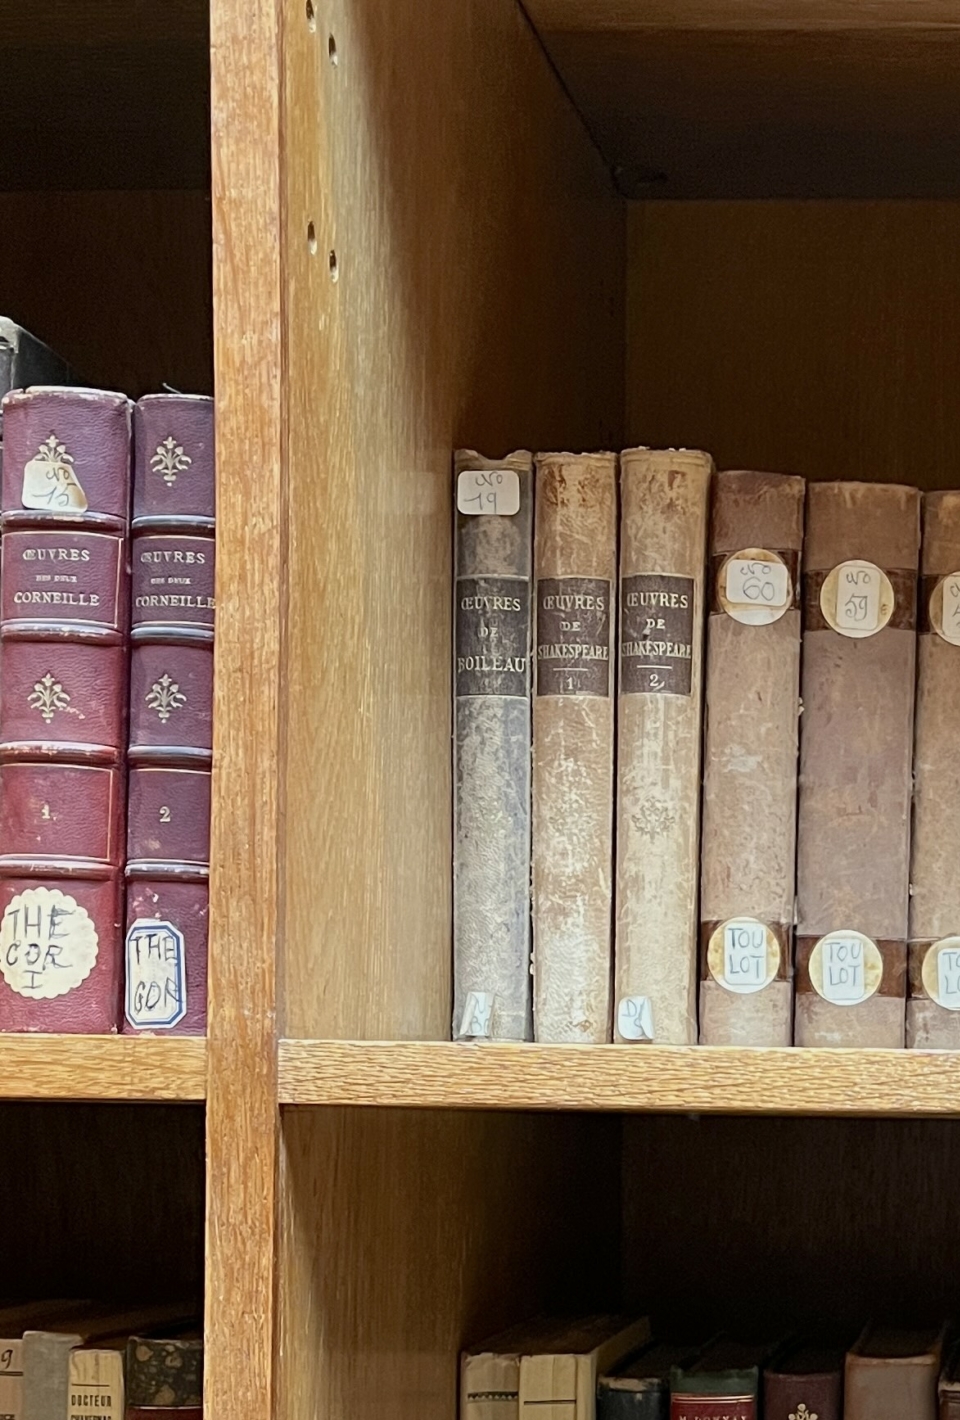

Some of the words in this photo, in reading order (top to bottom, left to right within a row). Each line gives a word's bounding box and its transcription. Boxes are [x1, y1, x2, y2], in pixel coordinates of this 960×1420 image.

[22, 549, 91, 562] ŒUVRES
[742, 576, 776, 601] 60
[14, 591, 100, 607] CORNEILLE
[461, 596, 521, 611] ŒUVRES
[543, 595, 605, 611] ŒUVRES
[627, 592, 689, 609] ŒUVRES
[480, 626, 499, 638] DE
[561, 621, 581, 632] DE
[646, 618, 666, 630] DE
[457, 655, 526, 673] BOILEAU
[566, 677, 575, 690] 1
[159, 806, 171, 823] 2
[7, 904, 76, 940] THE
[728, 928, 763, 948] TOU
[130, 933, 181, 965] THE
[825, 941, 863, 963] TOU
[729, 954, 764, 978] LOT
[828, 964, 862, 987] LOT
[71, 1394, 112, 1408] DOCTEUR
